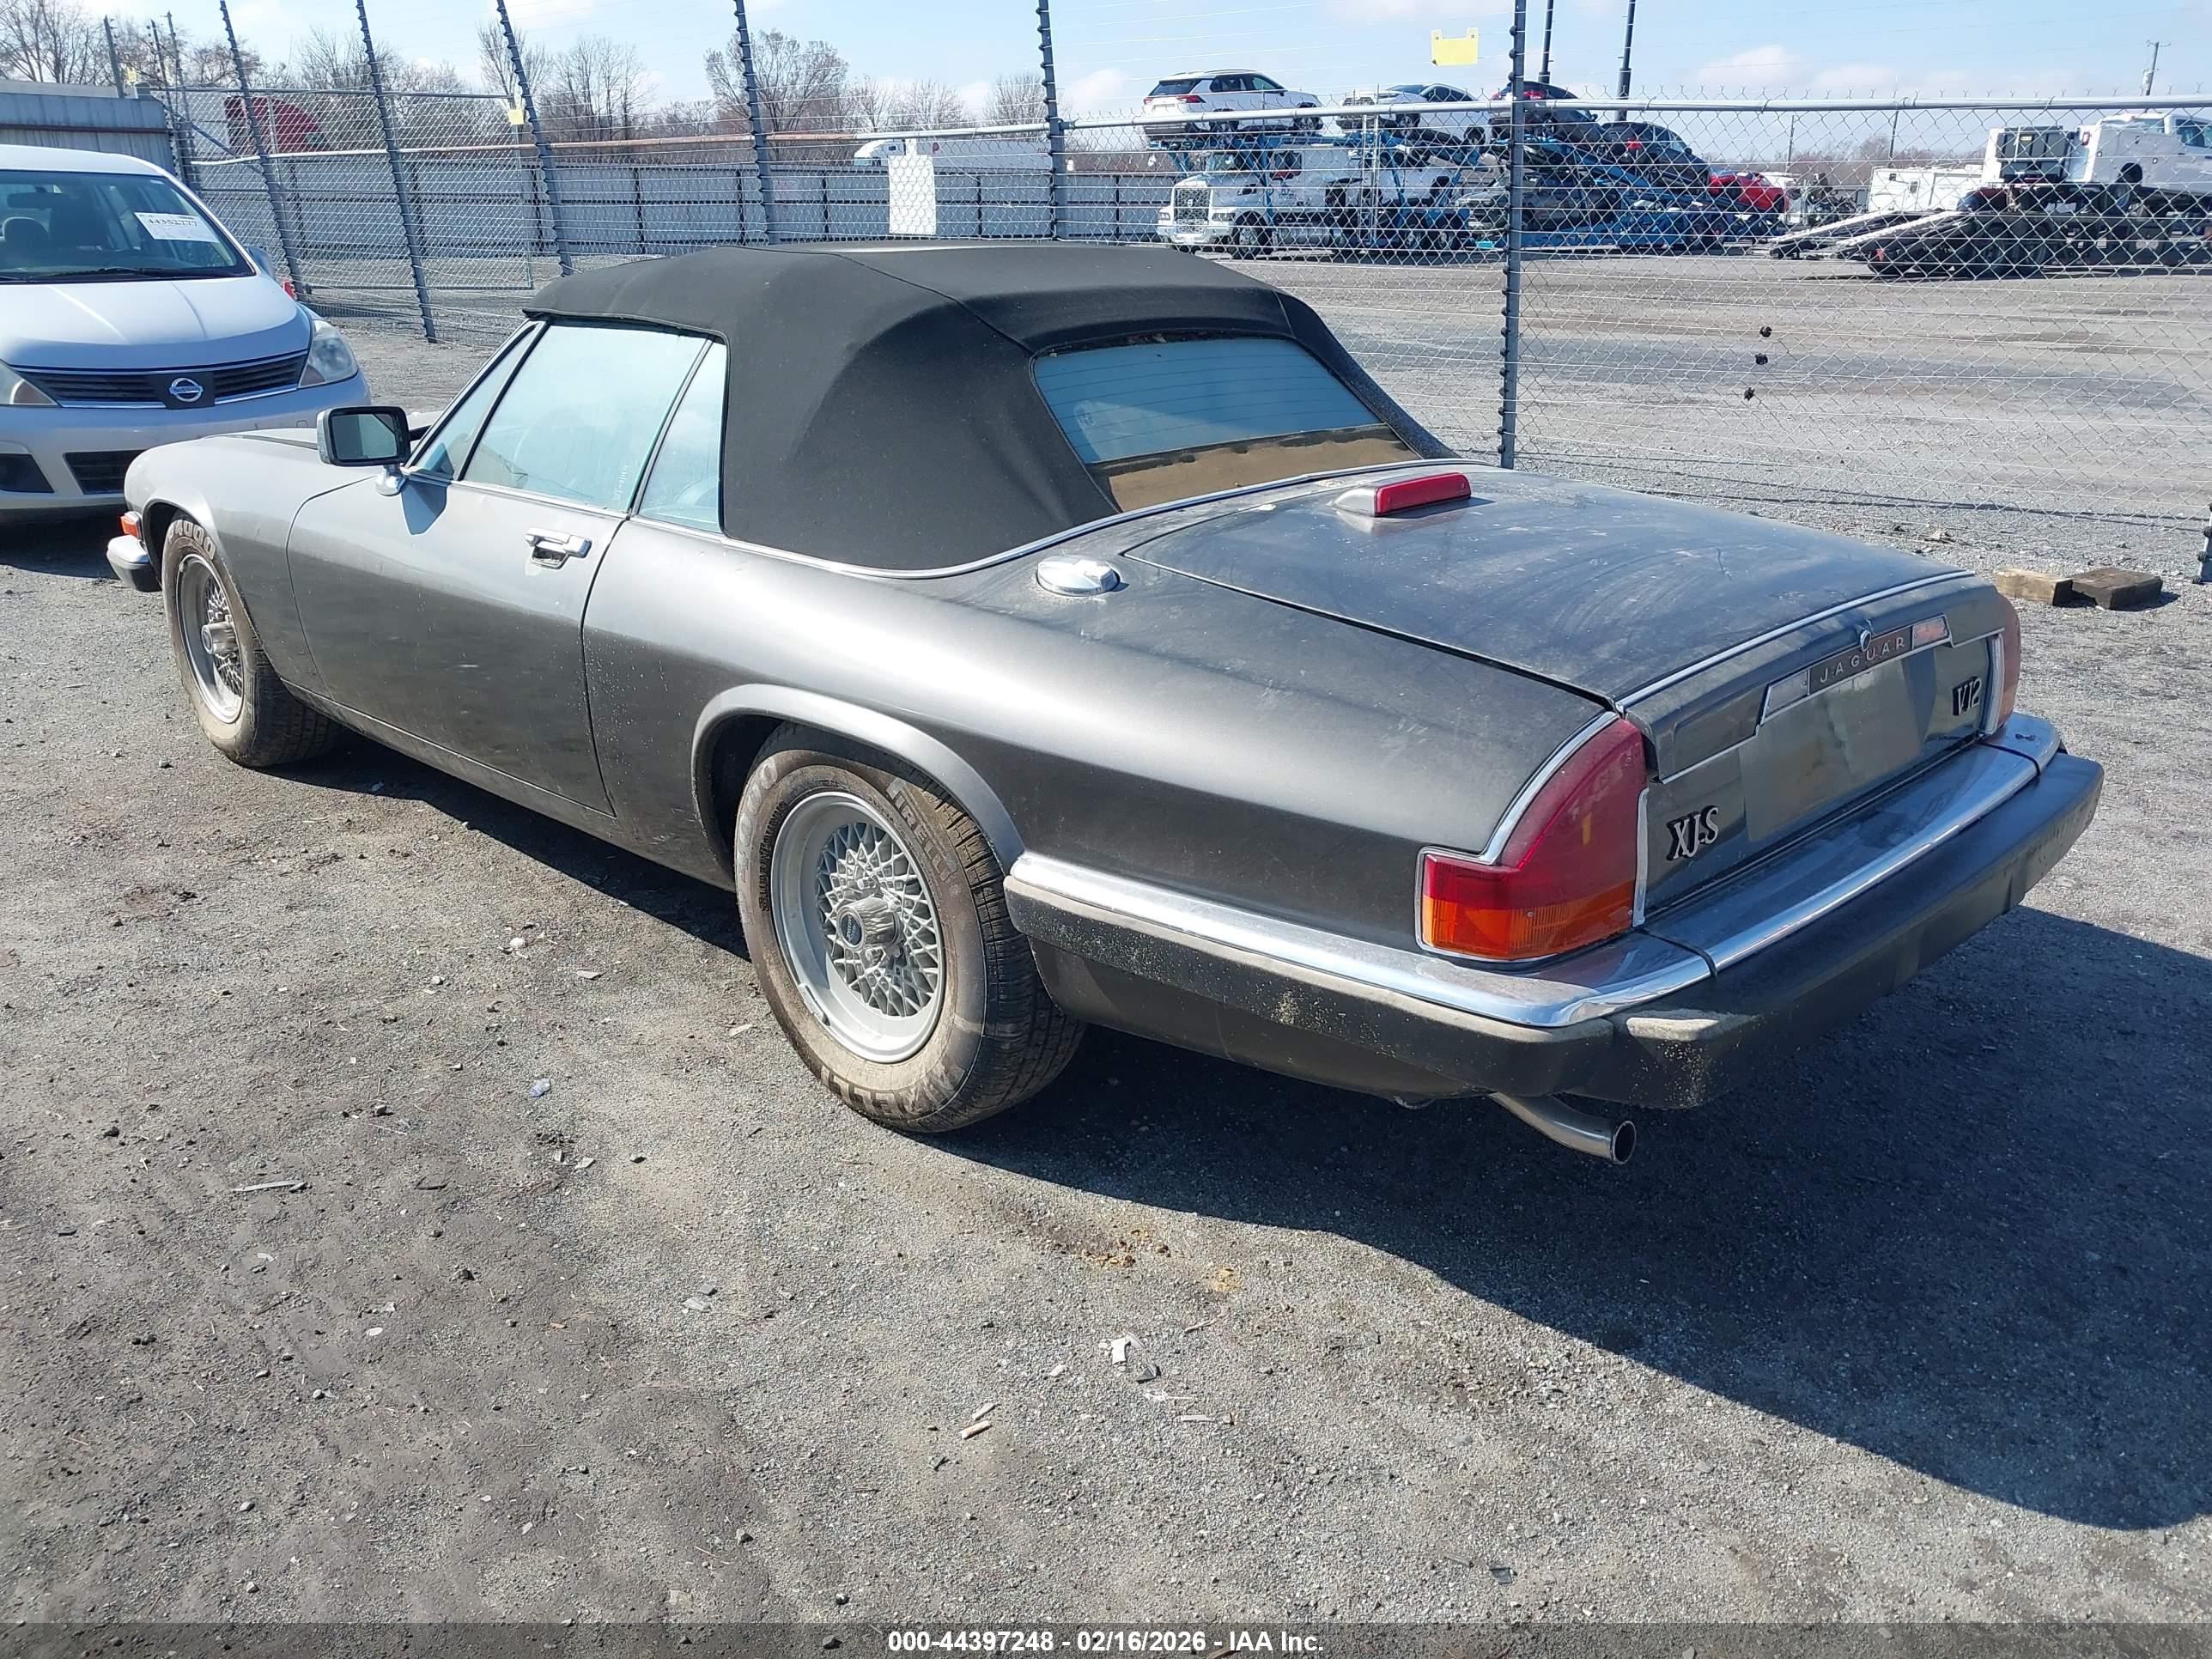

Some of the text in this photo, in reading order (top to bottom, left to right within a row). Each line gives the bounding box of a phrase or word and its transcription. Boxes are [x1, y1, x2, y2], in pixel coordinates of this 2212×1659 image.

[1820, 636, 1905, 684] JAGUAR
[1953, 676, 1982, 716] V12
[885, 776, 958, 882] PIRELLI
